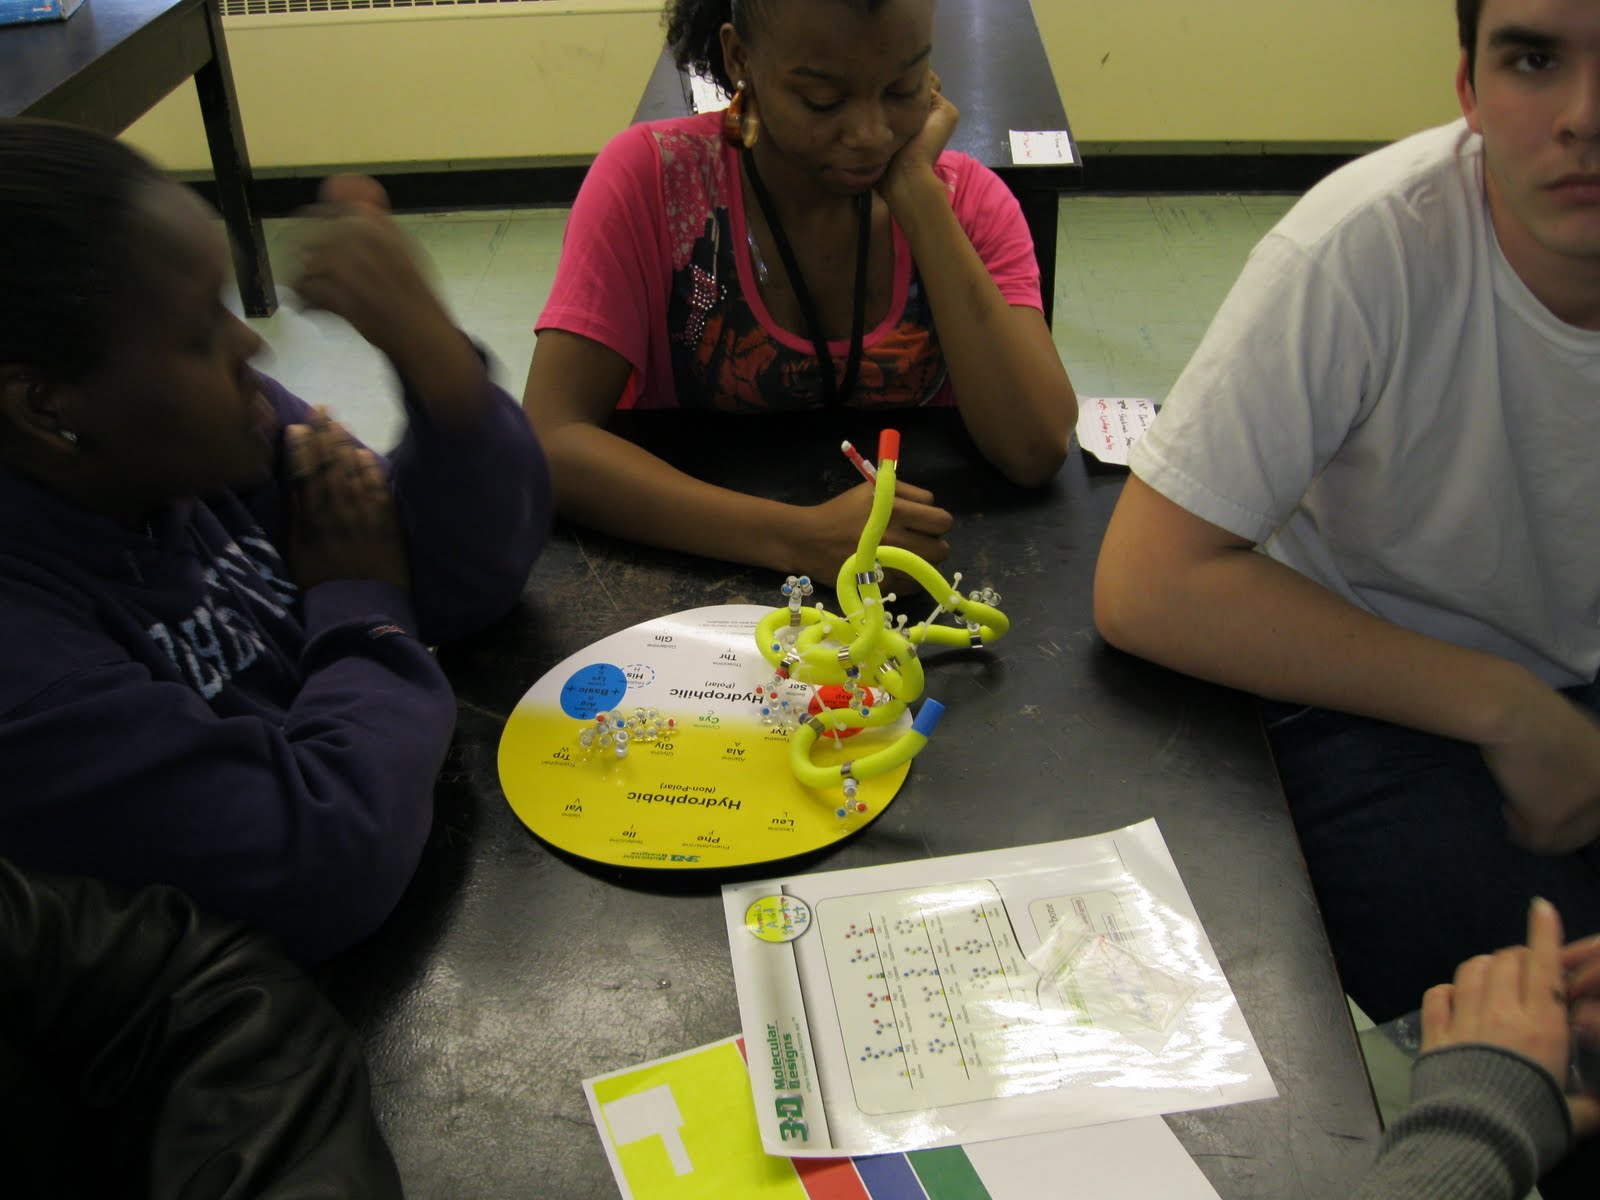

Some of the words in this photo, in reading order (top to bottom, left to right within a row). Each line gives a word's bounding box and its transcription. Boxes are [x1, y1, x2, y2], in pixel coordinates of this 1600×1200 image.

[719, 653, 737, 661] Thr
[788, 683, 807, 691] Ser
[578, 688, 609, 696] Basic
[669, 688, 764, 704] Hydrophilic
[698, 715, 719, 724] Cys
[770, 728, 788, 736] Tyr
[654, 742, 674, 750] Gly
[726, 747, 745, 755] Ala
[553, 752, 570, 761] Trp
[659, 782, 716, 794] (Non-Polar)
[626, 791, 742, 811] Hydrophobic
[565, 804, 583, 812] Val
[771, 818, 795, 826] Leu
[622, 830, 636, 838] Ile
[697, 835, 721, 844] Phe
[766, 1023, 785, 1090] Molecular
[782, 1033, 801, 1090] Designs
